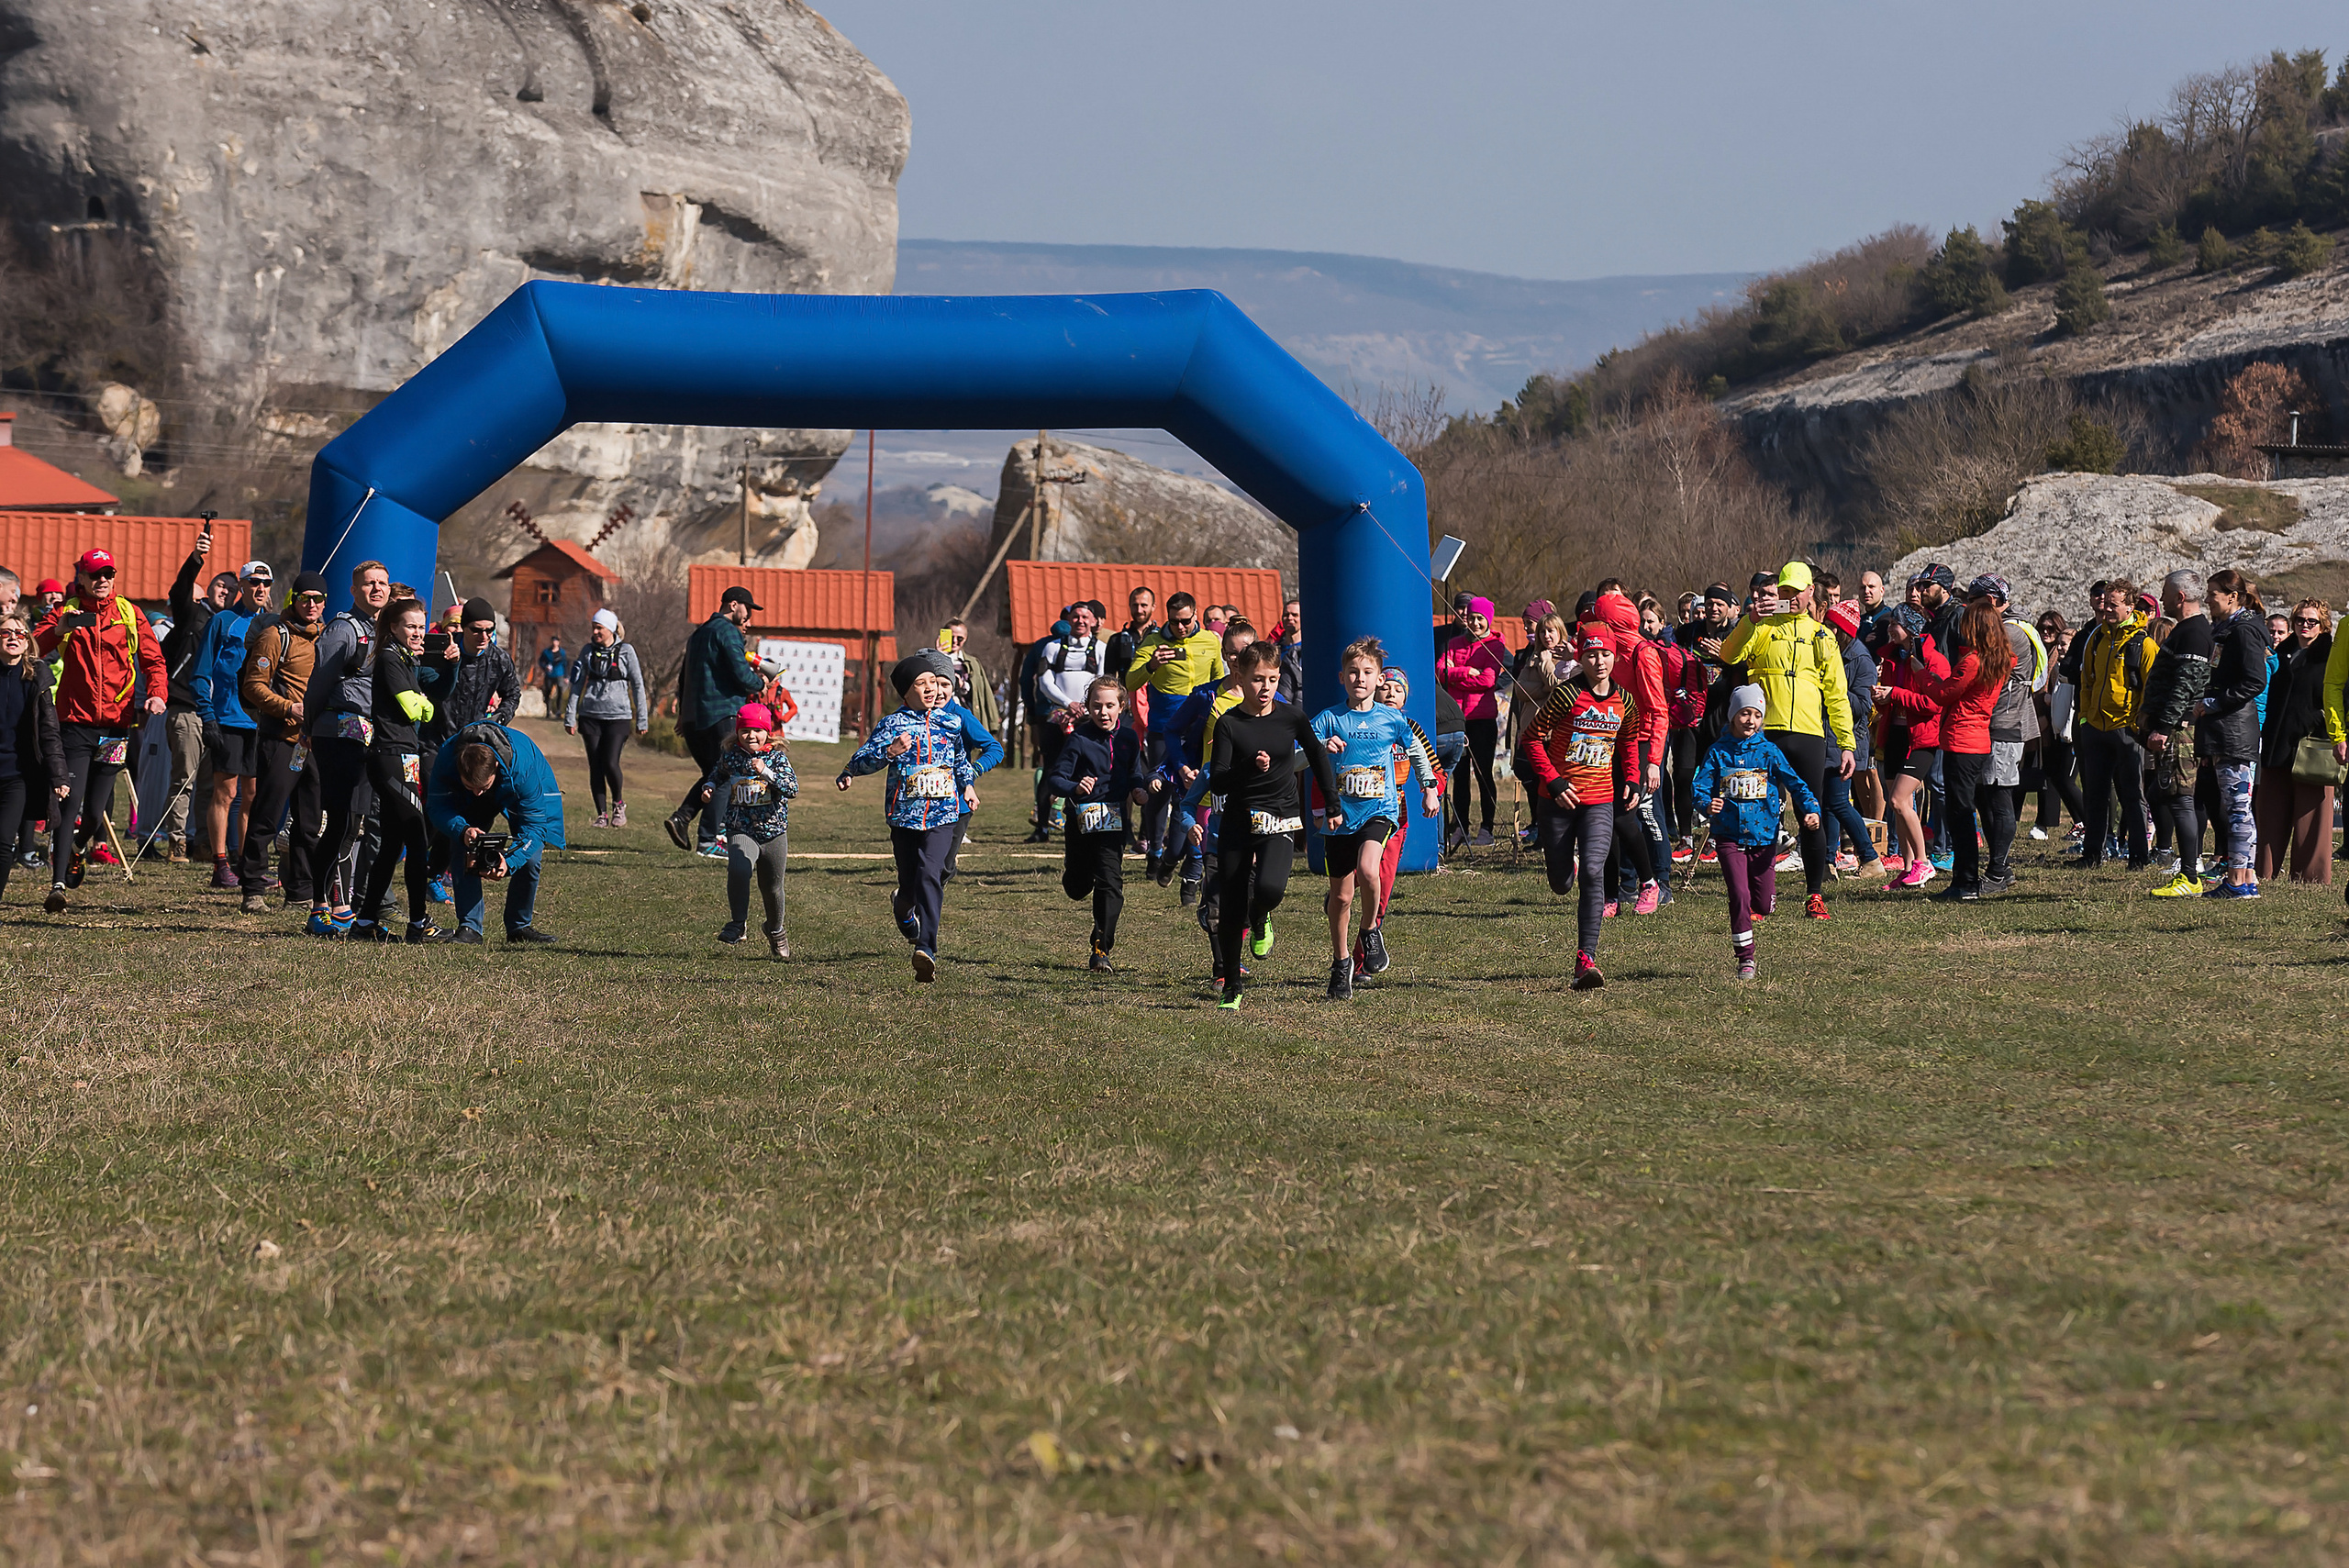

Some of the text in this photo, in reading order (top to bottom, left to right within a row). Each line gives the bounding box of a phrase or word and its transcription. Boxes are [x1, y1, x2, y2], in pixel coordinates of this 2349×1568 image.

[1575, 741, 1604, 766] 011
[737, 784, 761, 805] 007
[1345, 773, 1375, 795] 004
[1730, 776, 1758, 797] 010
[1085, 811, 1112, 831] 002
